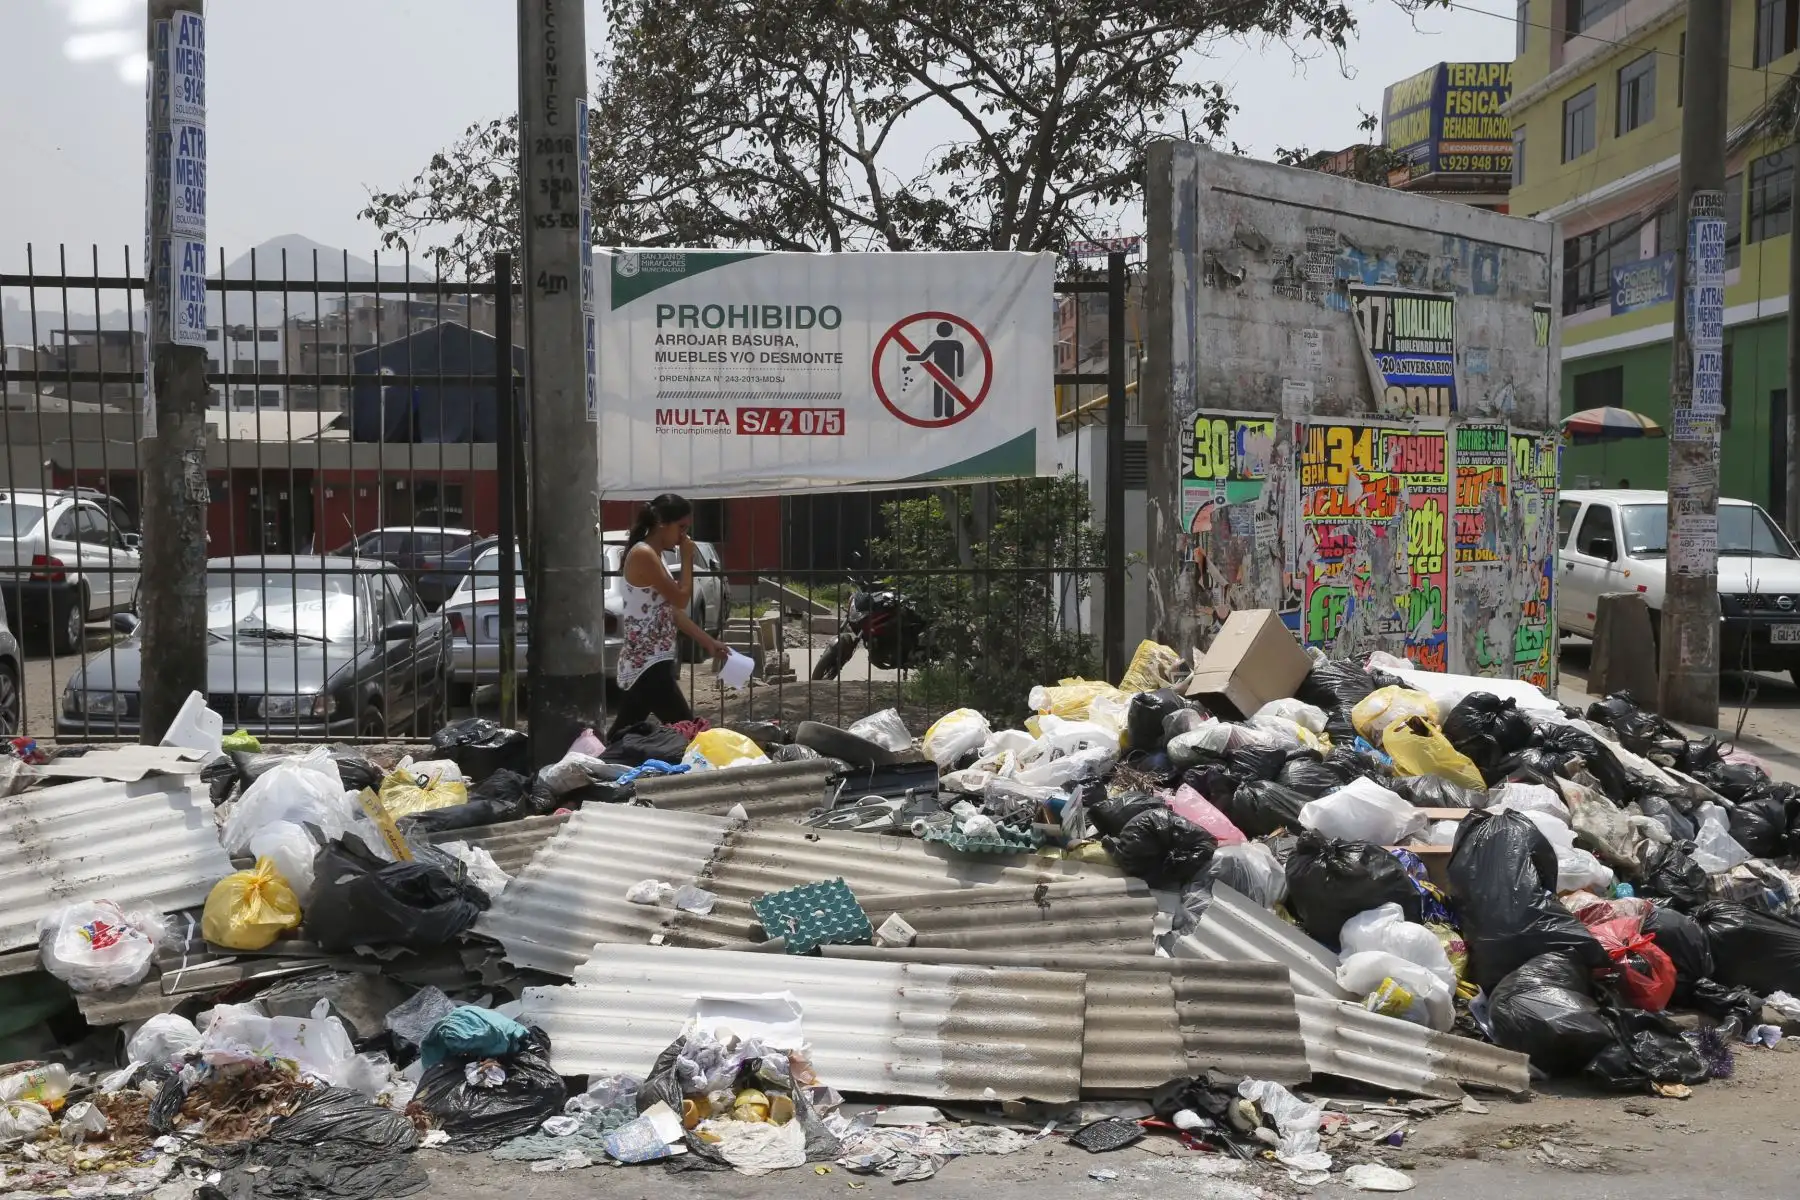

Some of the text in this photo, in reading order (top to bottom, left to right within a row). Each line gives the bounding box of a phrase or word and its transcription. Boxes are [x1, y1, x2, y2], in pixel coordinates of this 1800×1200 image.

[656, 304, 842, 330] PROHIBIDO
[655, 334, 799, 348] ARROJAR BASURA,
[1395, 340, 1434, 353] BOULEVARD
[655, 351, 844, 364] MUEBLES Y/O DESMONTE
[659, 375, 712, 383] ORDENANZA
[655, 408, 841, 434] MULTA S/. 2 075
[655, 427, 732, 436] Por incumplimiento
[1194, 417, 1230, 478] 30
[1326, 426, 1374, 486] 31
